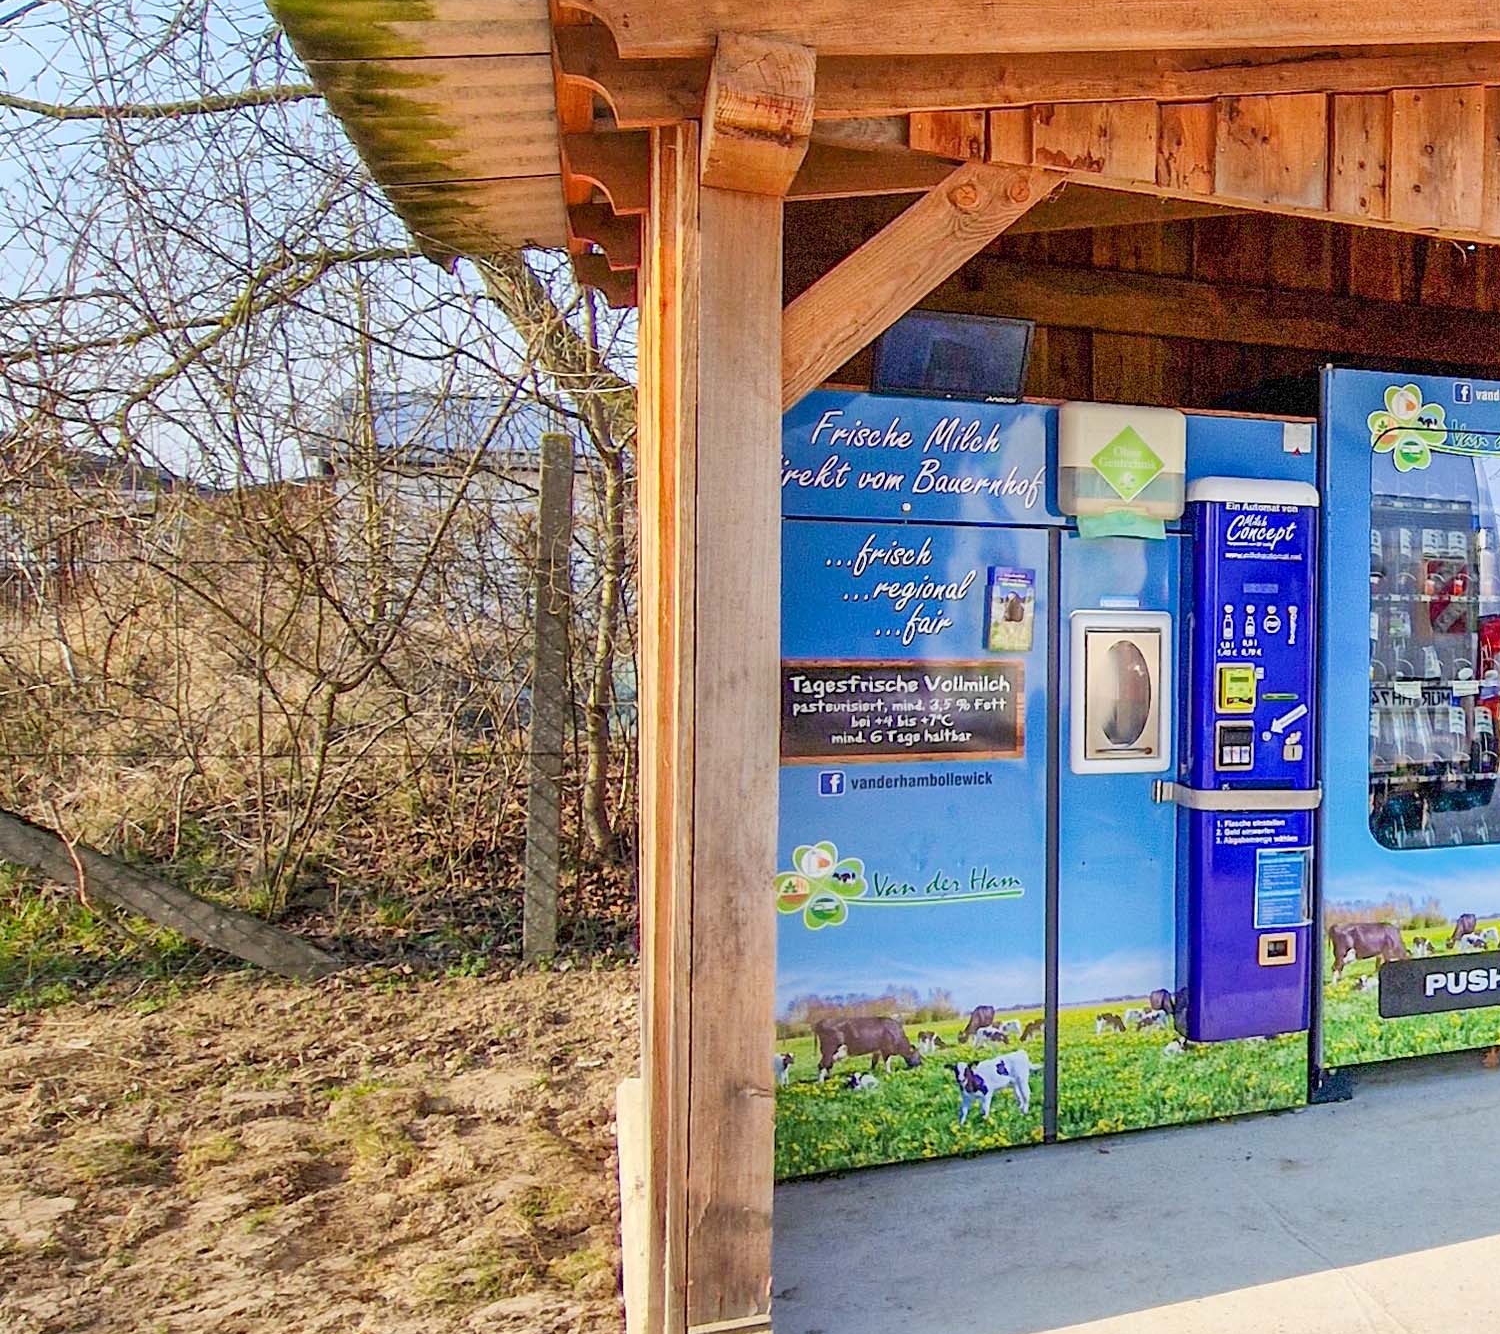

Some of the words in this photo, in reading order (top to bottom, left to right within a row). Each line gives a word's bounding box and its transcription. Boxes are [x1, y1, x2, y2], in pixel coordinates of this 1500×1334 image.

[810, 410, 913, 449] Frische
[923, 417, 1001, 453] Milch
[1451, 419, 1489, 447] Van
[781, 455, 851, 488] irekt
[857, 470, 904, 492] vom
[912, 459, 1048, 510] Bauernhof
[1226, 514, 1297, 551] Concept
[789, 674, 919, 699] Tagesfrische
[923, 675, 1011, 693] Vollmilch
[792, 698, 888, 716] pasteurisiert,
[892, 699, 924, 712] mind.
[956, 699, 972, 711] %
[974, 698, 1007, 711] Fett
[850, 715, 871, 728] bei
[874, 715, 893, 728] +4
[897, 715, 917, 727] bis
[831, 731, 866, 744] mind.
[870, 731, 883, 743] 6
[888, 730, 921, 747] Tage
[924, 729, 973, 743] haltbar
[851, 771, 993, 790] vanderhambollewick
[872, 871, 916, 897] Van
[926, 871, 960, 892] der
[969, 867, 1021, 891] Ham
